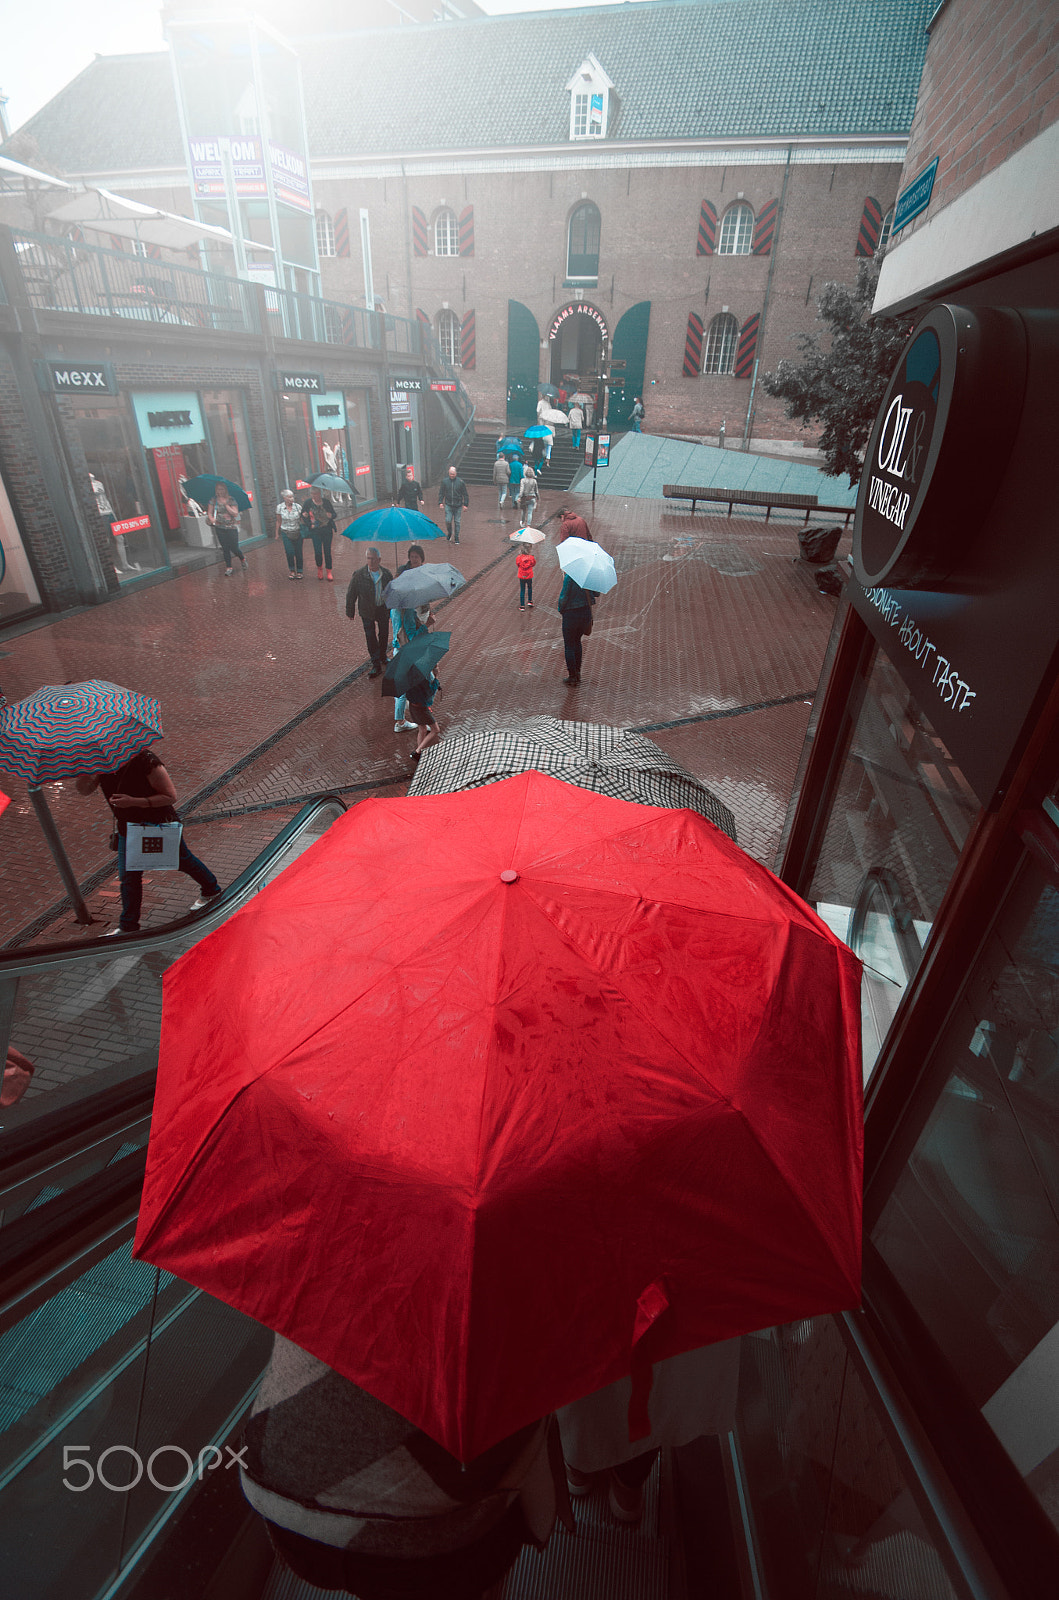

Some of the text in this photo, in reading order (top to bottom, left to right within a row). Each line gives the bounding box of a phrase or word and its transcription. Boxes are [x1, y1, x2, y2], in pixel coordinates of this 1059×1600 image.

[190, 141, 261, 161] WELOM!
[549, 304, 609, 341] VLAAMS ARSENAAL
[155, 446, 181, 458] SALE
[878, 394, 914, 478] OIL
[868, 475, 911, 530] VINEGAR
[113, 524, 122, 532] UP
[139, 517, 149, 526] OFF
[898, 615, 936, 669] ABOUT
[932, 655, 976, 712] TASTE
